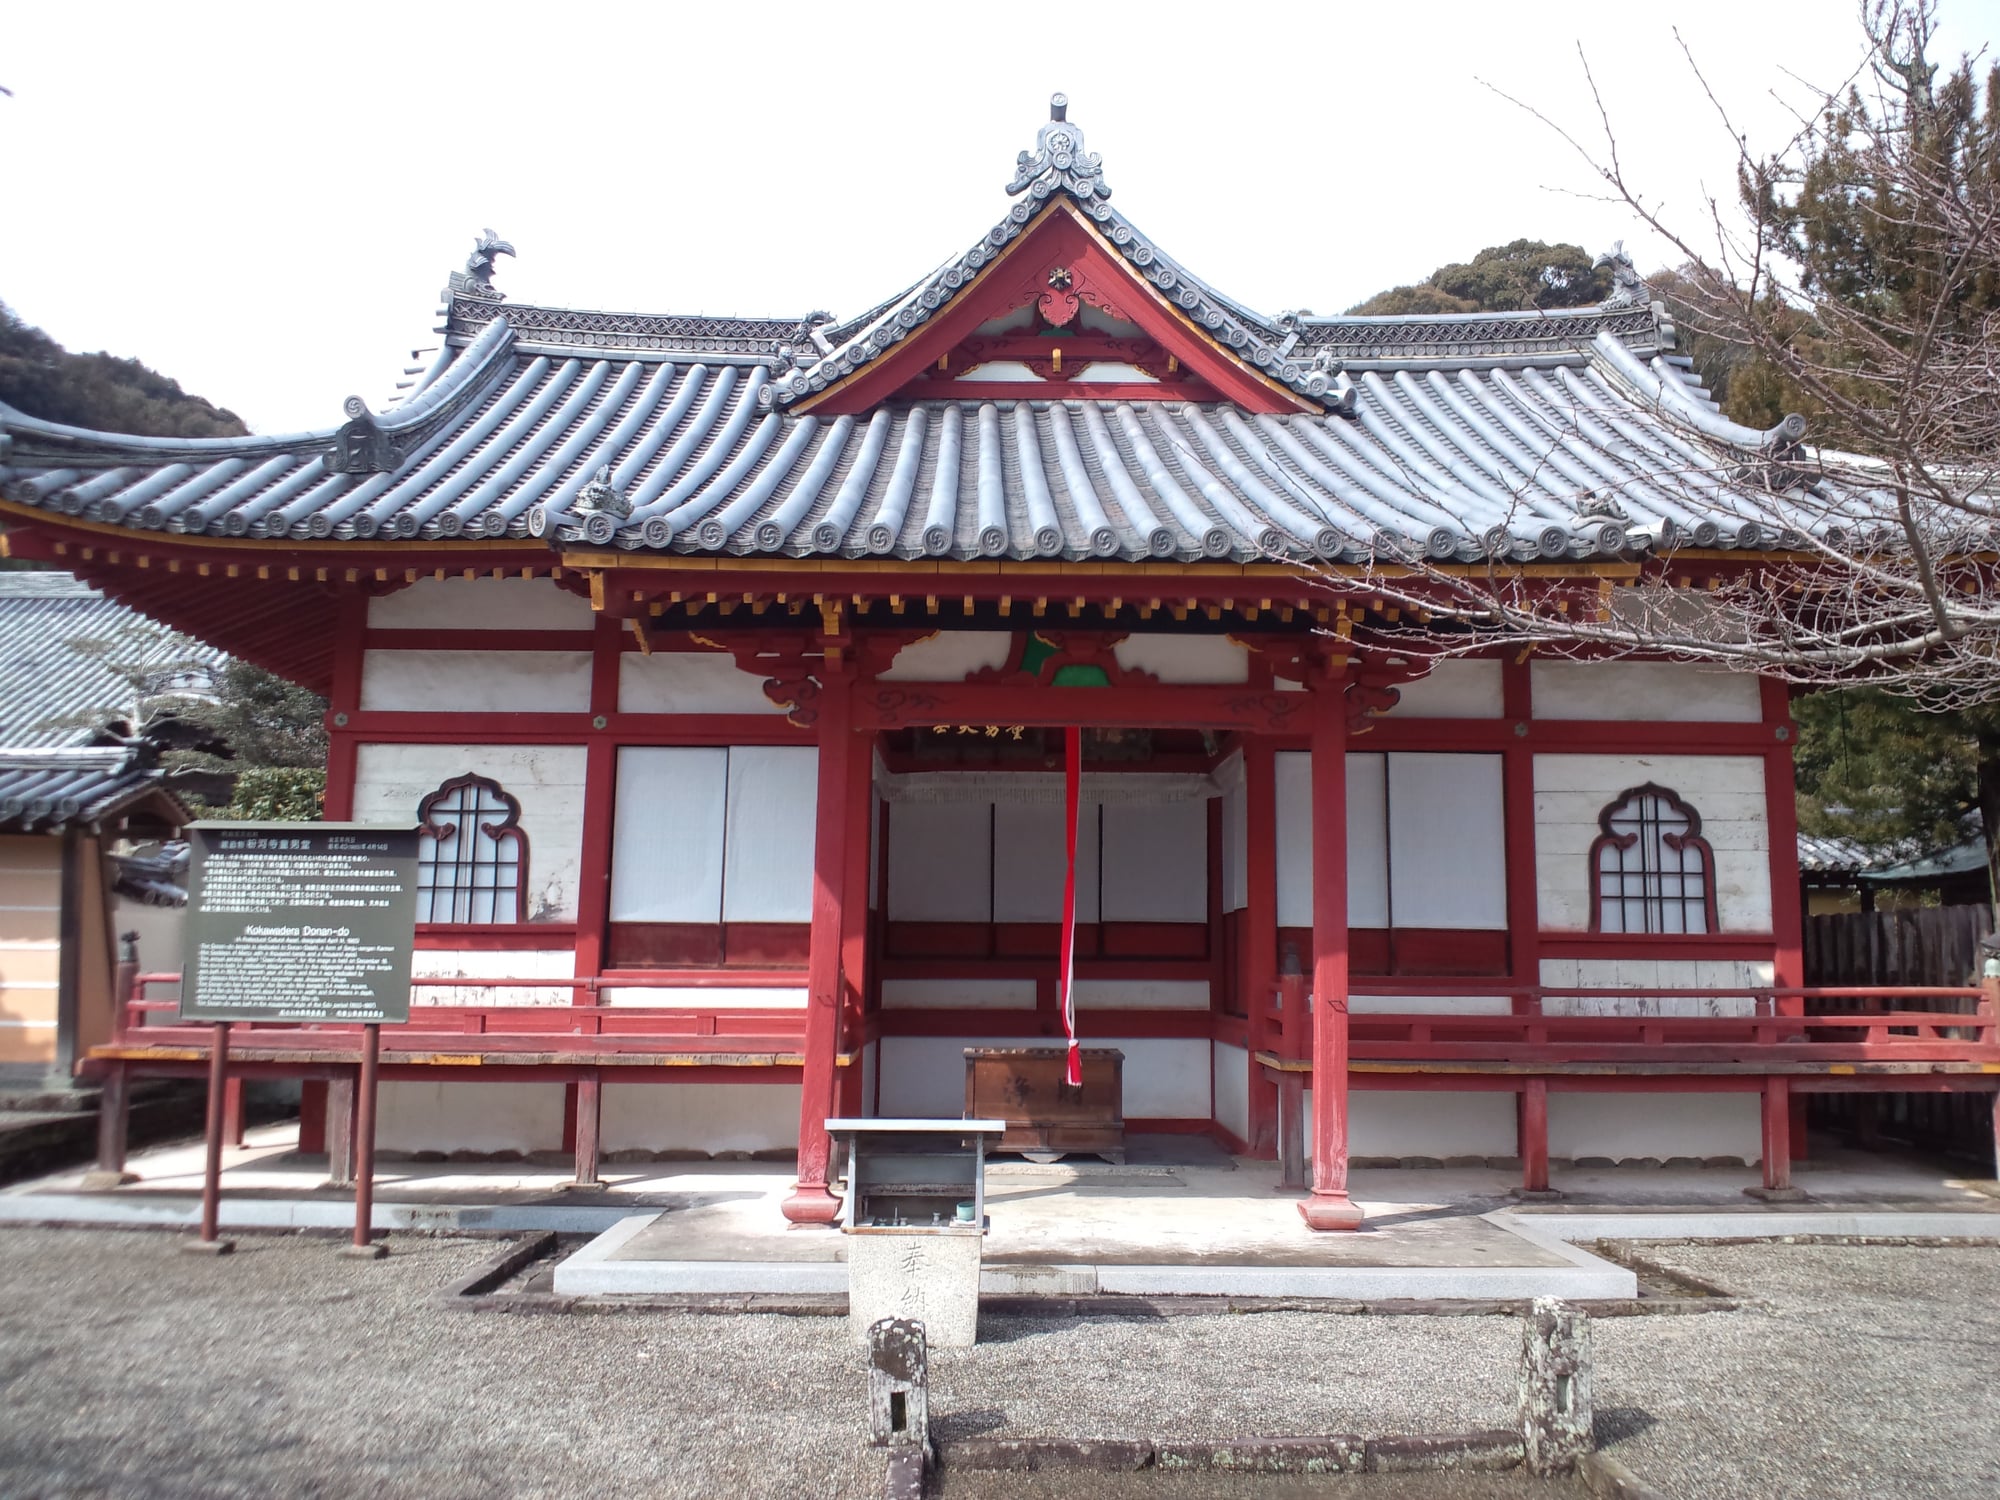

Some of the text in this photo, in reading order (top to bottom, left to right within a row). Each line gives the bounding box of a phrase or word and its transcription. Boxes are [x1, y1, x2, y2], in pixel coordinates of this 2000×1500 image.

[246, 925, 350, 936] Kokawadera Donan-do
[900, 1241, 932, 1314] 奉納
